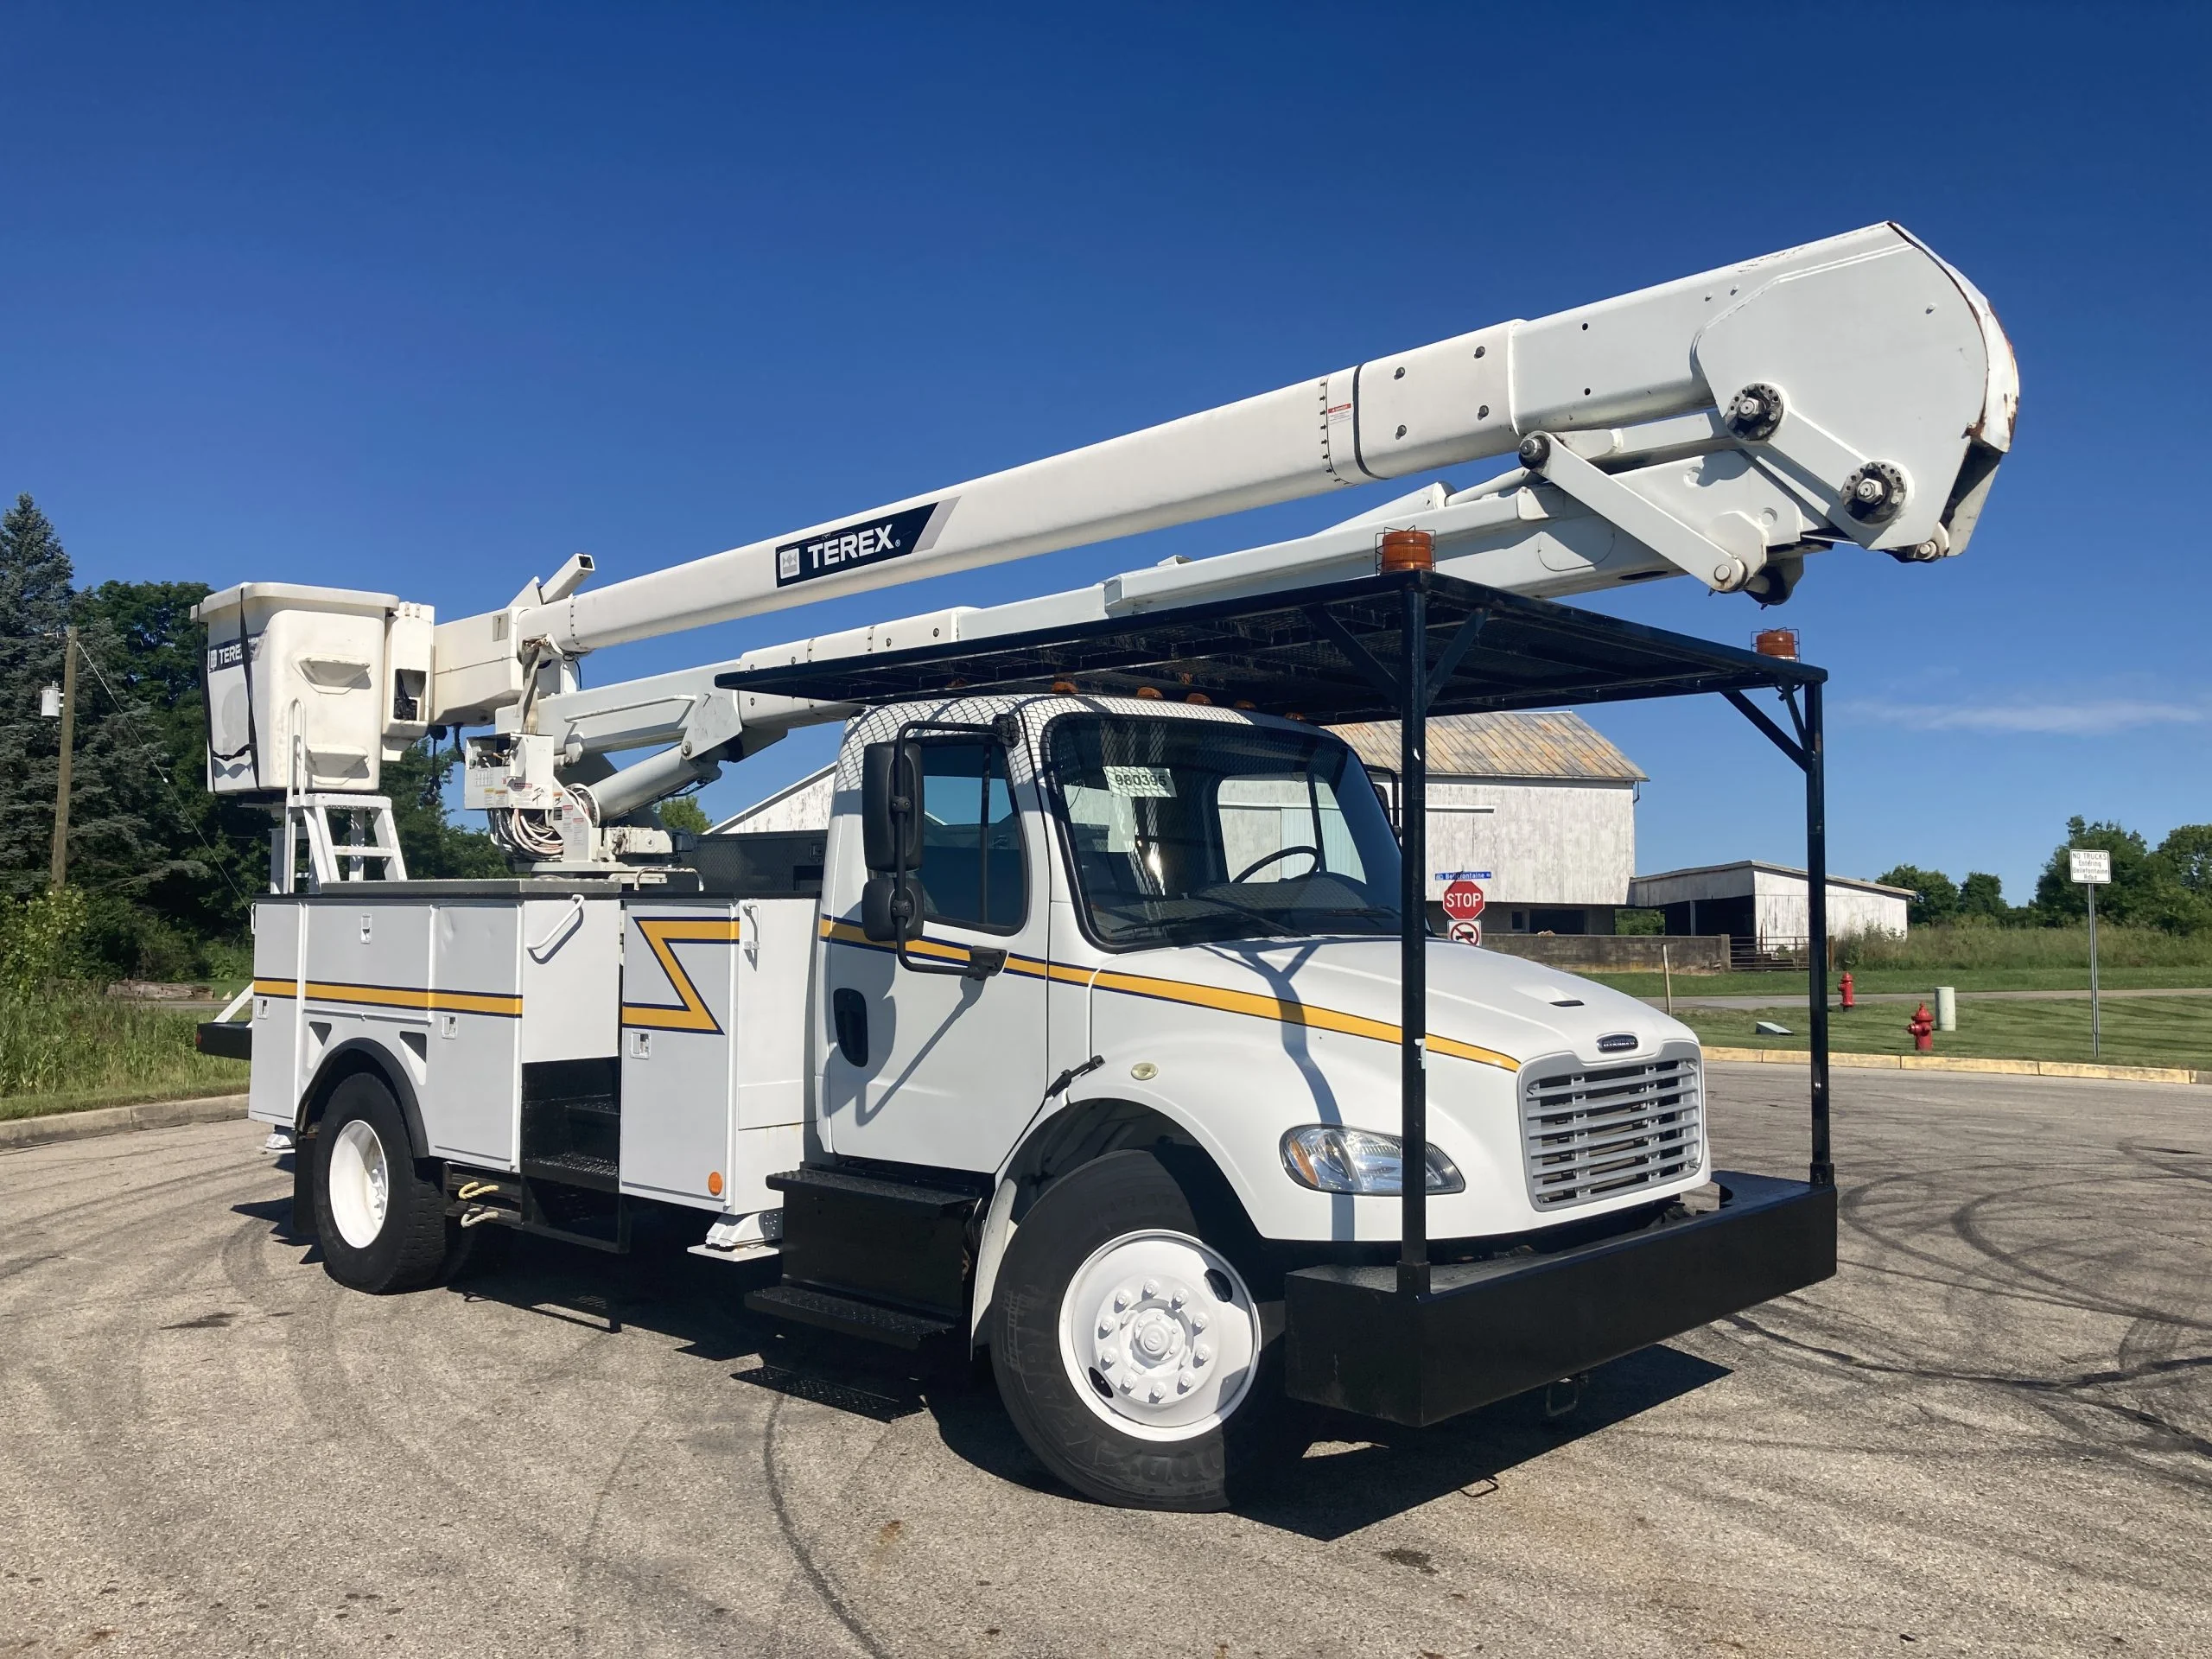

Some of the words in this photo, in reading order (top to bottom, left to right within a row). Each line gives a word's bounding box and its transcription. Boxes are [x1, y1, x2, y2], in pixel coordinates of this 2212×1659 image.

[807, 524, 893, 569] TEREX
[219, 642, 243, 664] TERE
[1115, 774, 1167, 786] 980395
[1446, 893, 1482, 907] STOP
